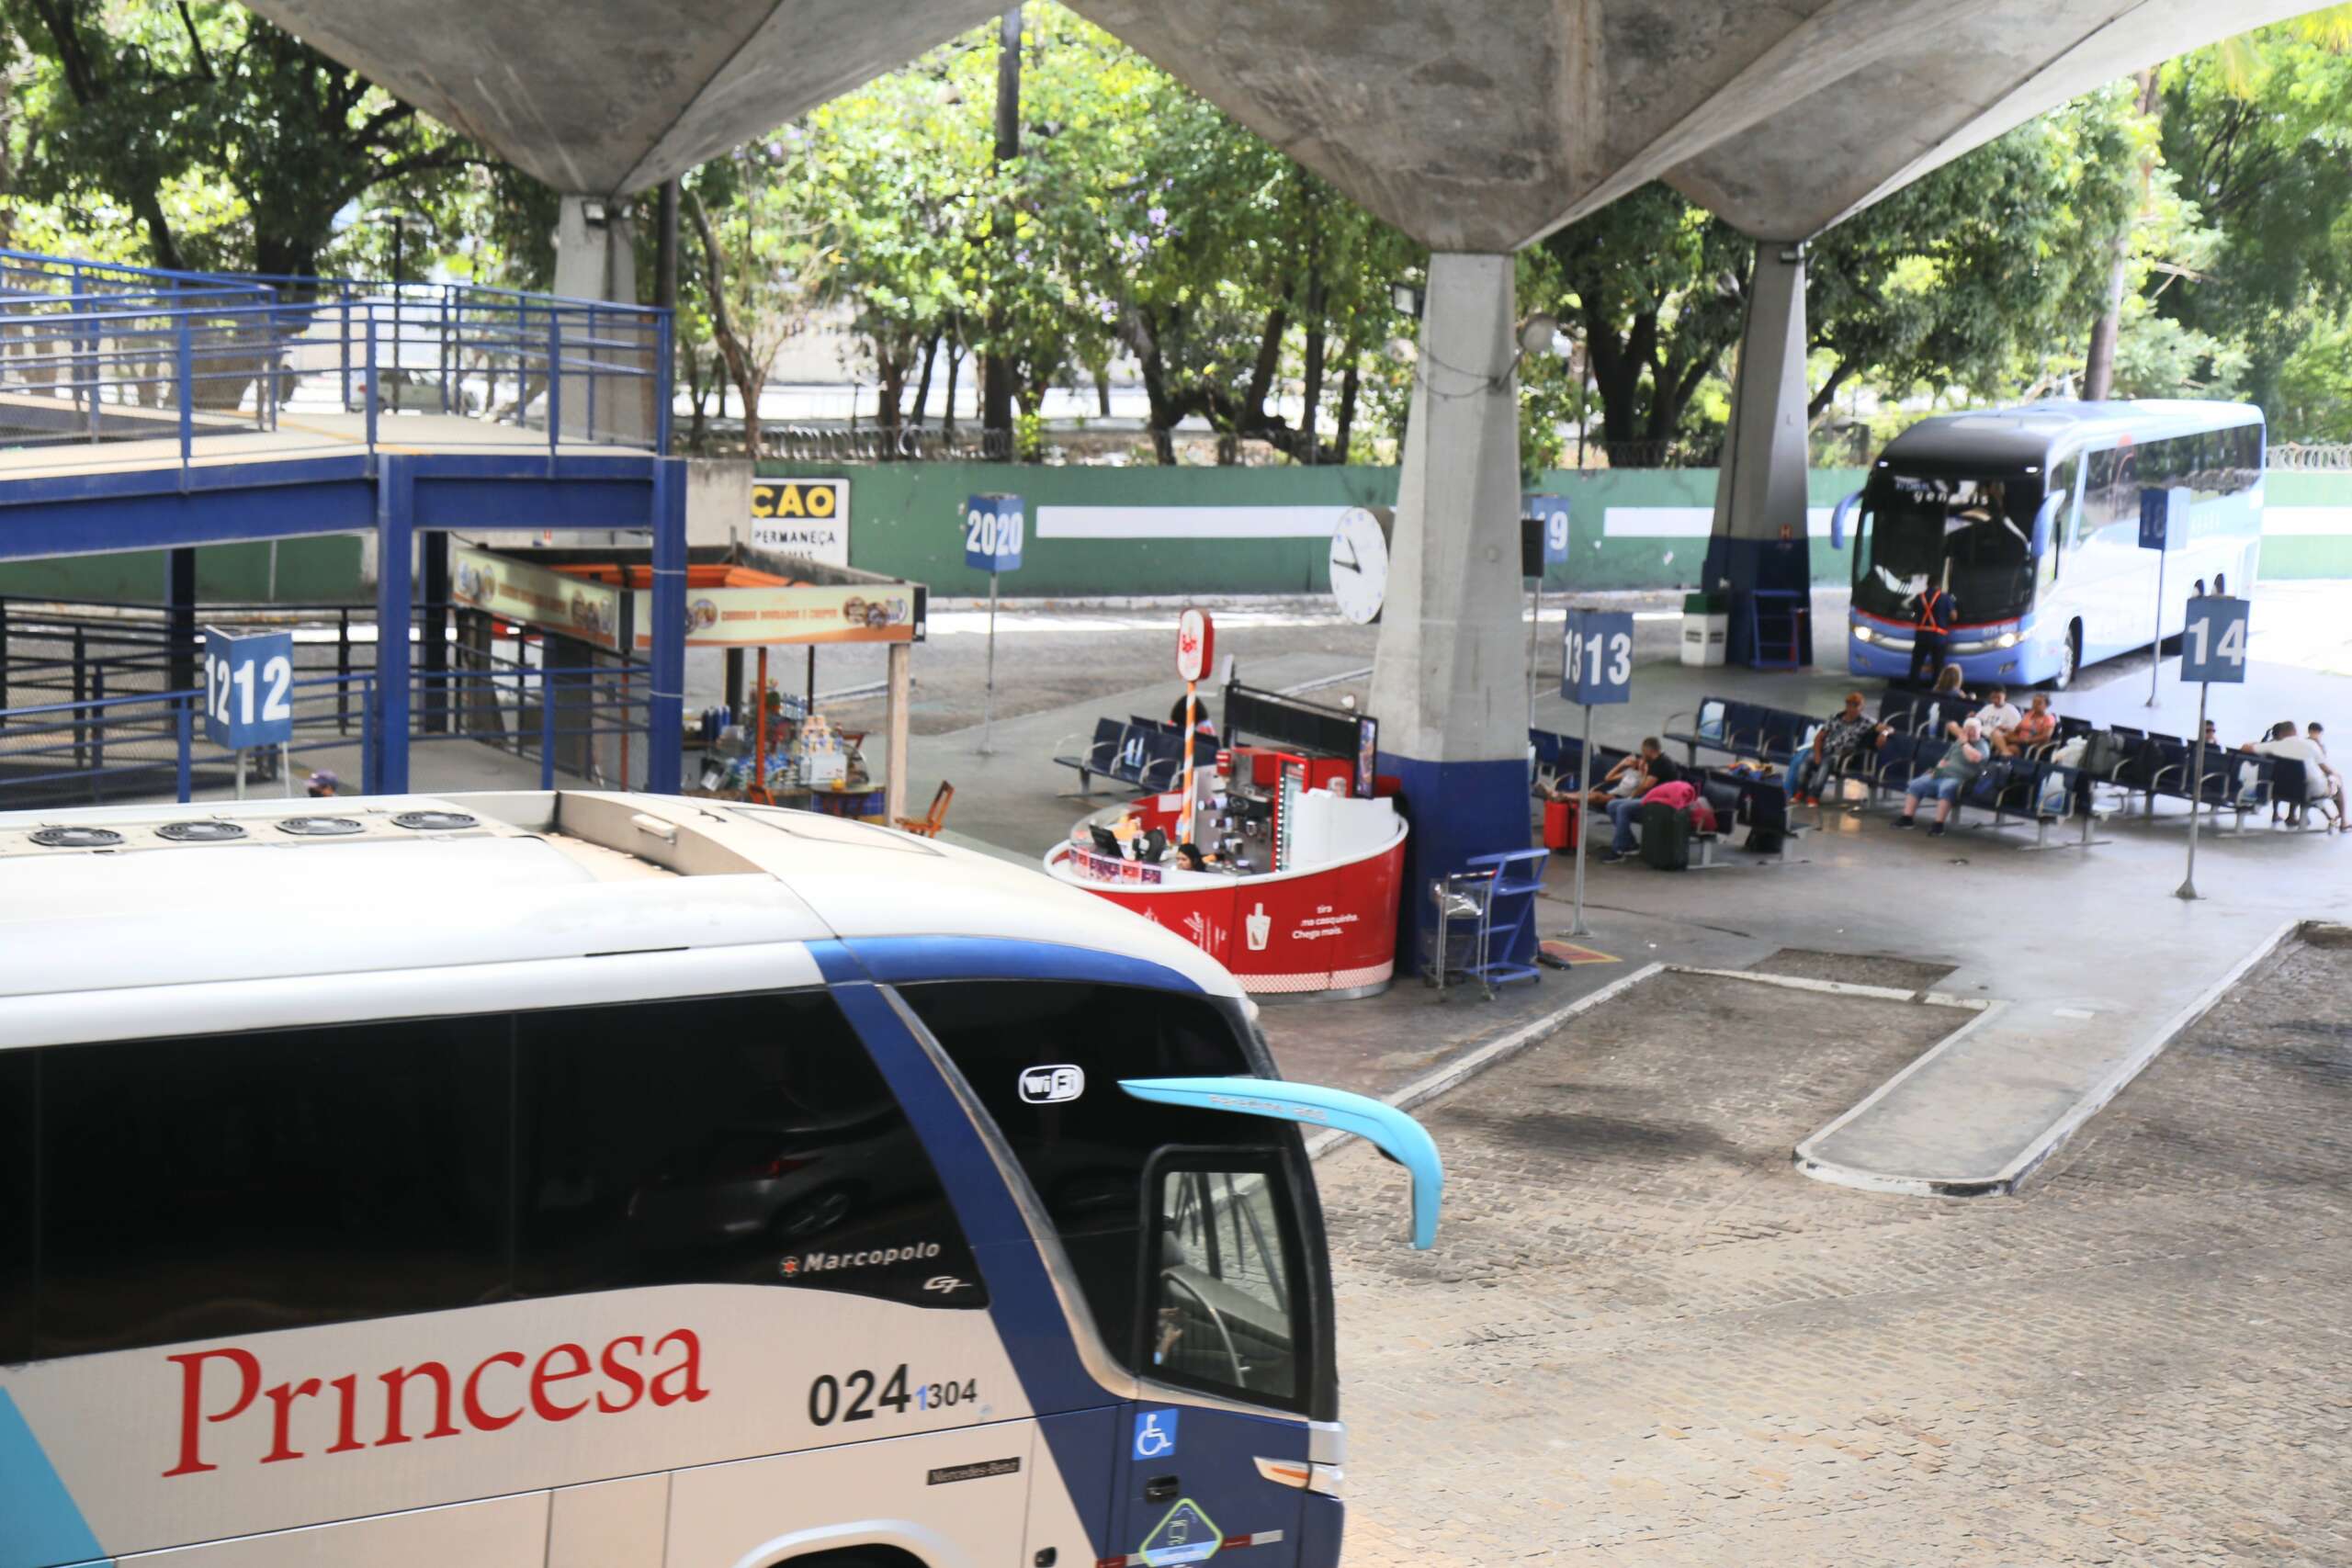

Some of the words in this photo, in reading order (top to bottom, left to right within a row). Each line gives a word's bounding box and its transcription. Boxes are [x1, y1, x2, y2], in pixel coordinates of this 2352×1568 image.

[754, 530, 836, 547] PERMANEÇA
[966, 509, 997, 556] 20
[995, 512, 1024, 557] 20
[1565, 629, 1583, 686] 13
[1586, 632, 1632, 686] 13
[2188, 616, 2246, 667] 14
[205, 653, 231, 726] 12
[233, 655, 292, 726] 12
[1292, 930, 1320, 941] Chega
[803, 1242, 941, 1272] Marcopolo
[162, 1328, 710, 1478] Princesa
[808, 1363, 911, 1427] 024
[915, 1378, 978, 1411] 1304
